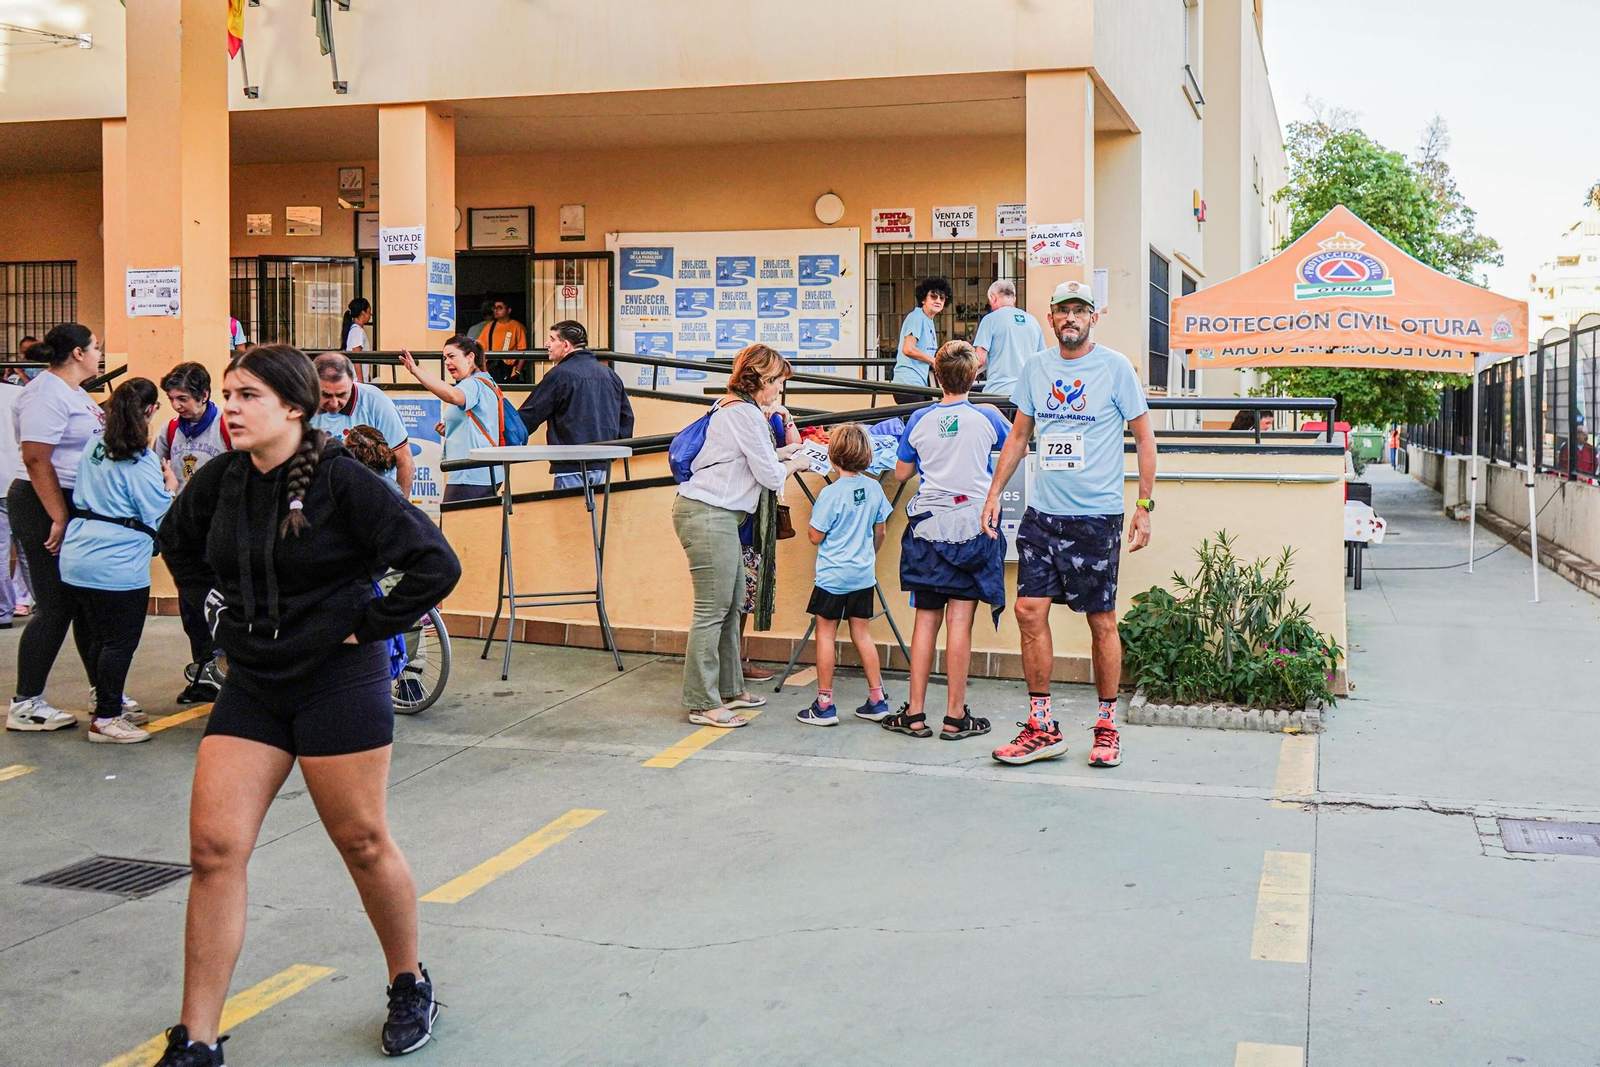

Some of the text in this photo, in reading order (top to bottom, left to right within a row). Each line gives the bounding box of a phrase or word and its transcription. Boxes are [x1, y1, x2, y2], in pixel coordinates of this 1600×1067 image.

[935, 211, 974, 220] VENTA DE
[939, 219, 970, 228] TICKETS
[383, 233, 422, 243] VENTA DE
[1030, 230, 1083, 240] PALOMITAS
[387, 242, 419, 252] TICKETS
[1363, 258, 1382, 276] CIVIL
[625, 294, 667, 304] ENVEJECER.
[620, 306, 672, 316] DECIDIR. VIVIR.
[1185, 310, 1483, 336] PROTECCIÓN CIVIL OTURA
[1047, 443, 1073, 455] 728
[806, 448, 828, 462] 729
[411, 482, 440, 496] VIVIR.
